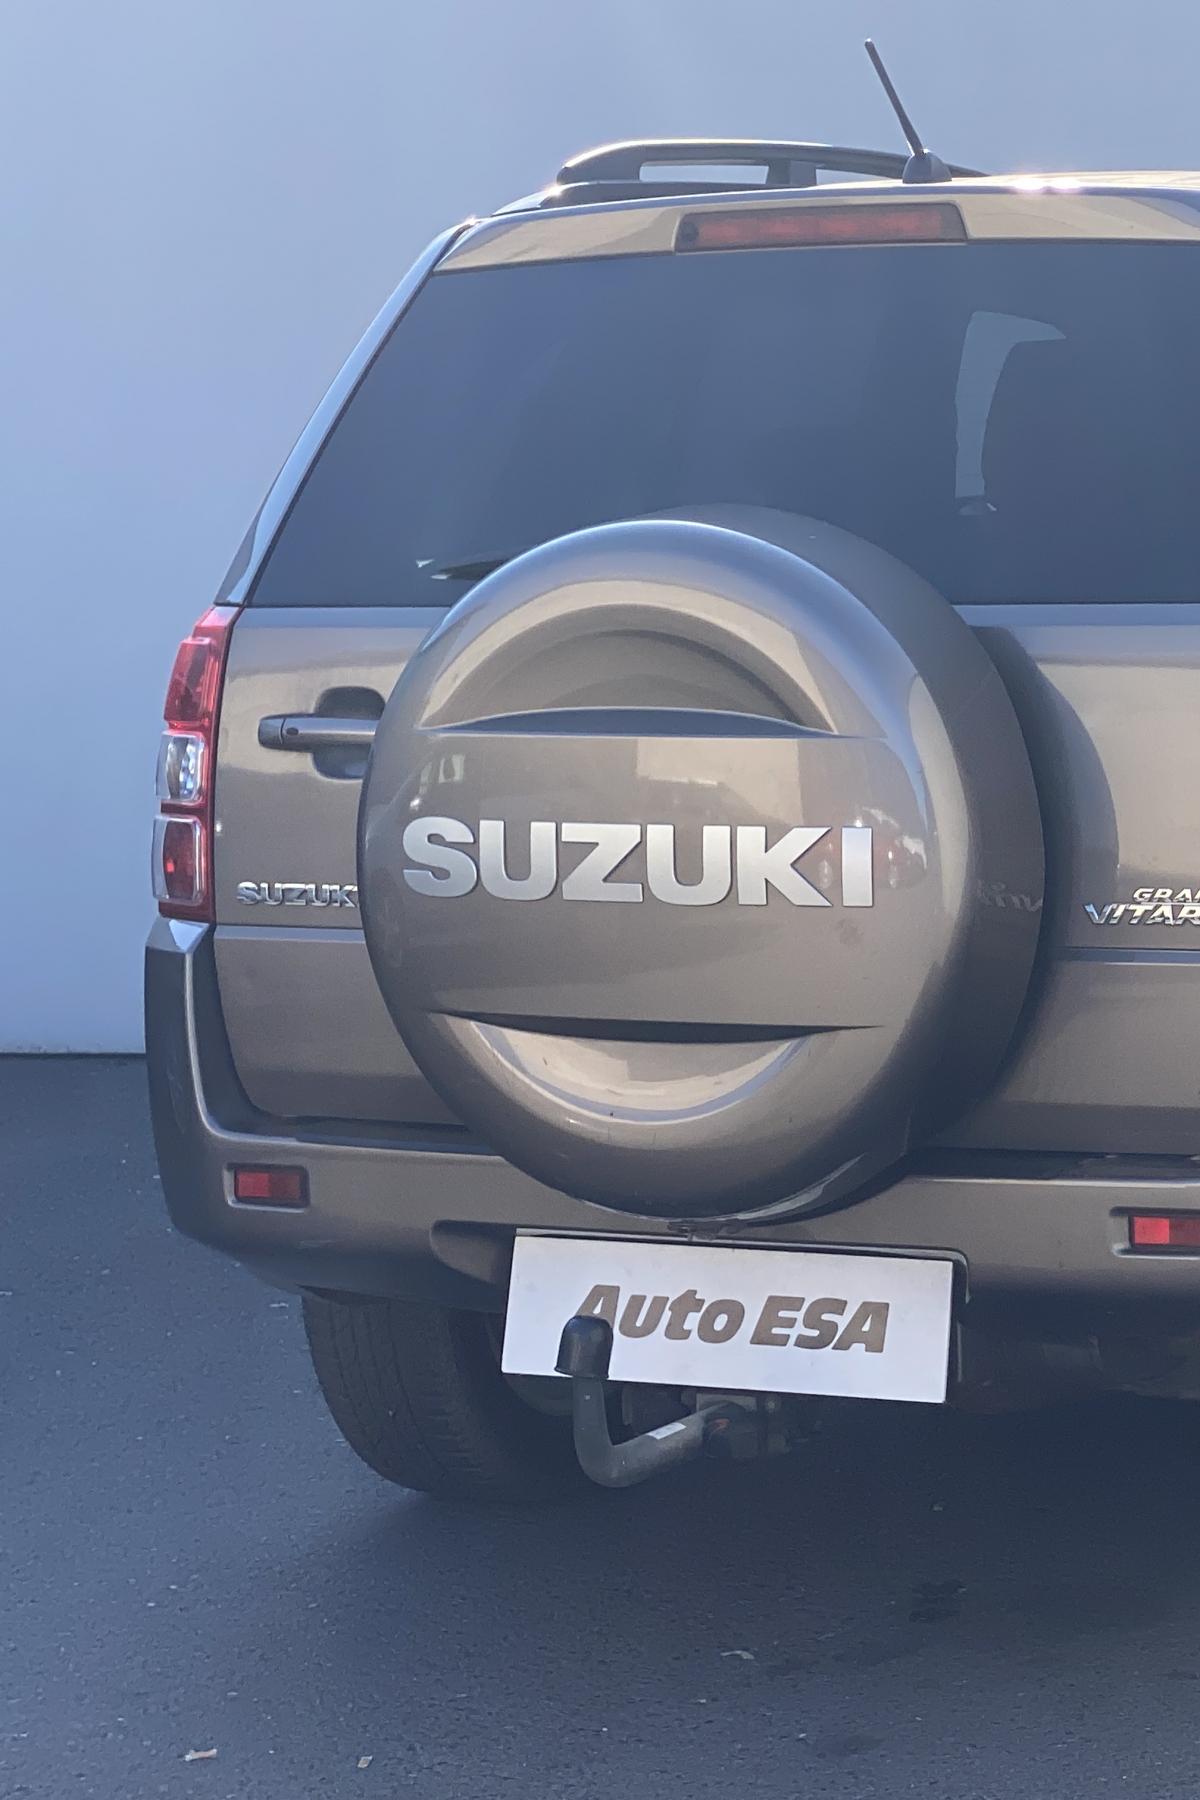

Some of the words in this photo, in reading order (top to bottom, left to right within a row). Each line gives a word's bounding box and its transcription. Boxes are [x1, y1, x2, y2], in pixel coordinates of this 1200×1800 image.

[236, 881, 358, 908] SUZUK
[401, 815, 874, 907] SUZUKI
[575, 1284, 746, 1344] Auto
[749, 1295, 890, 1353] ESA
